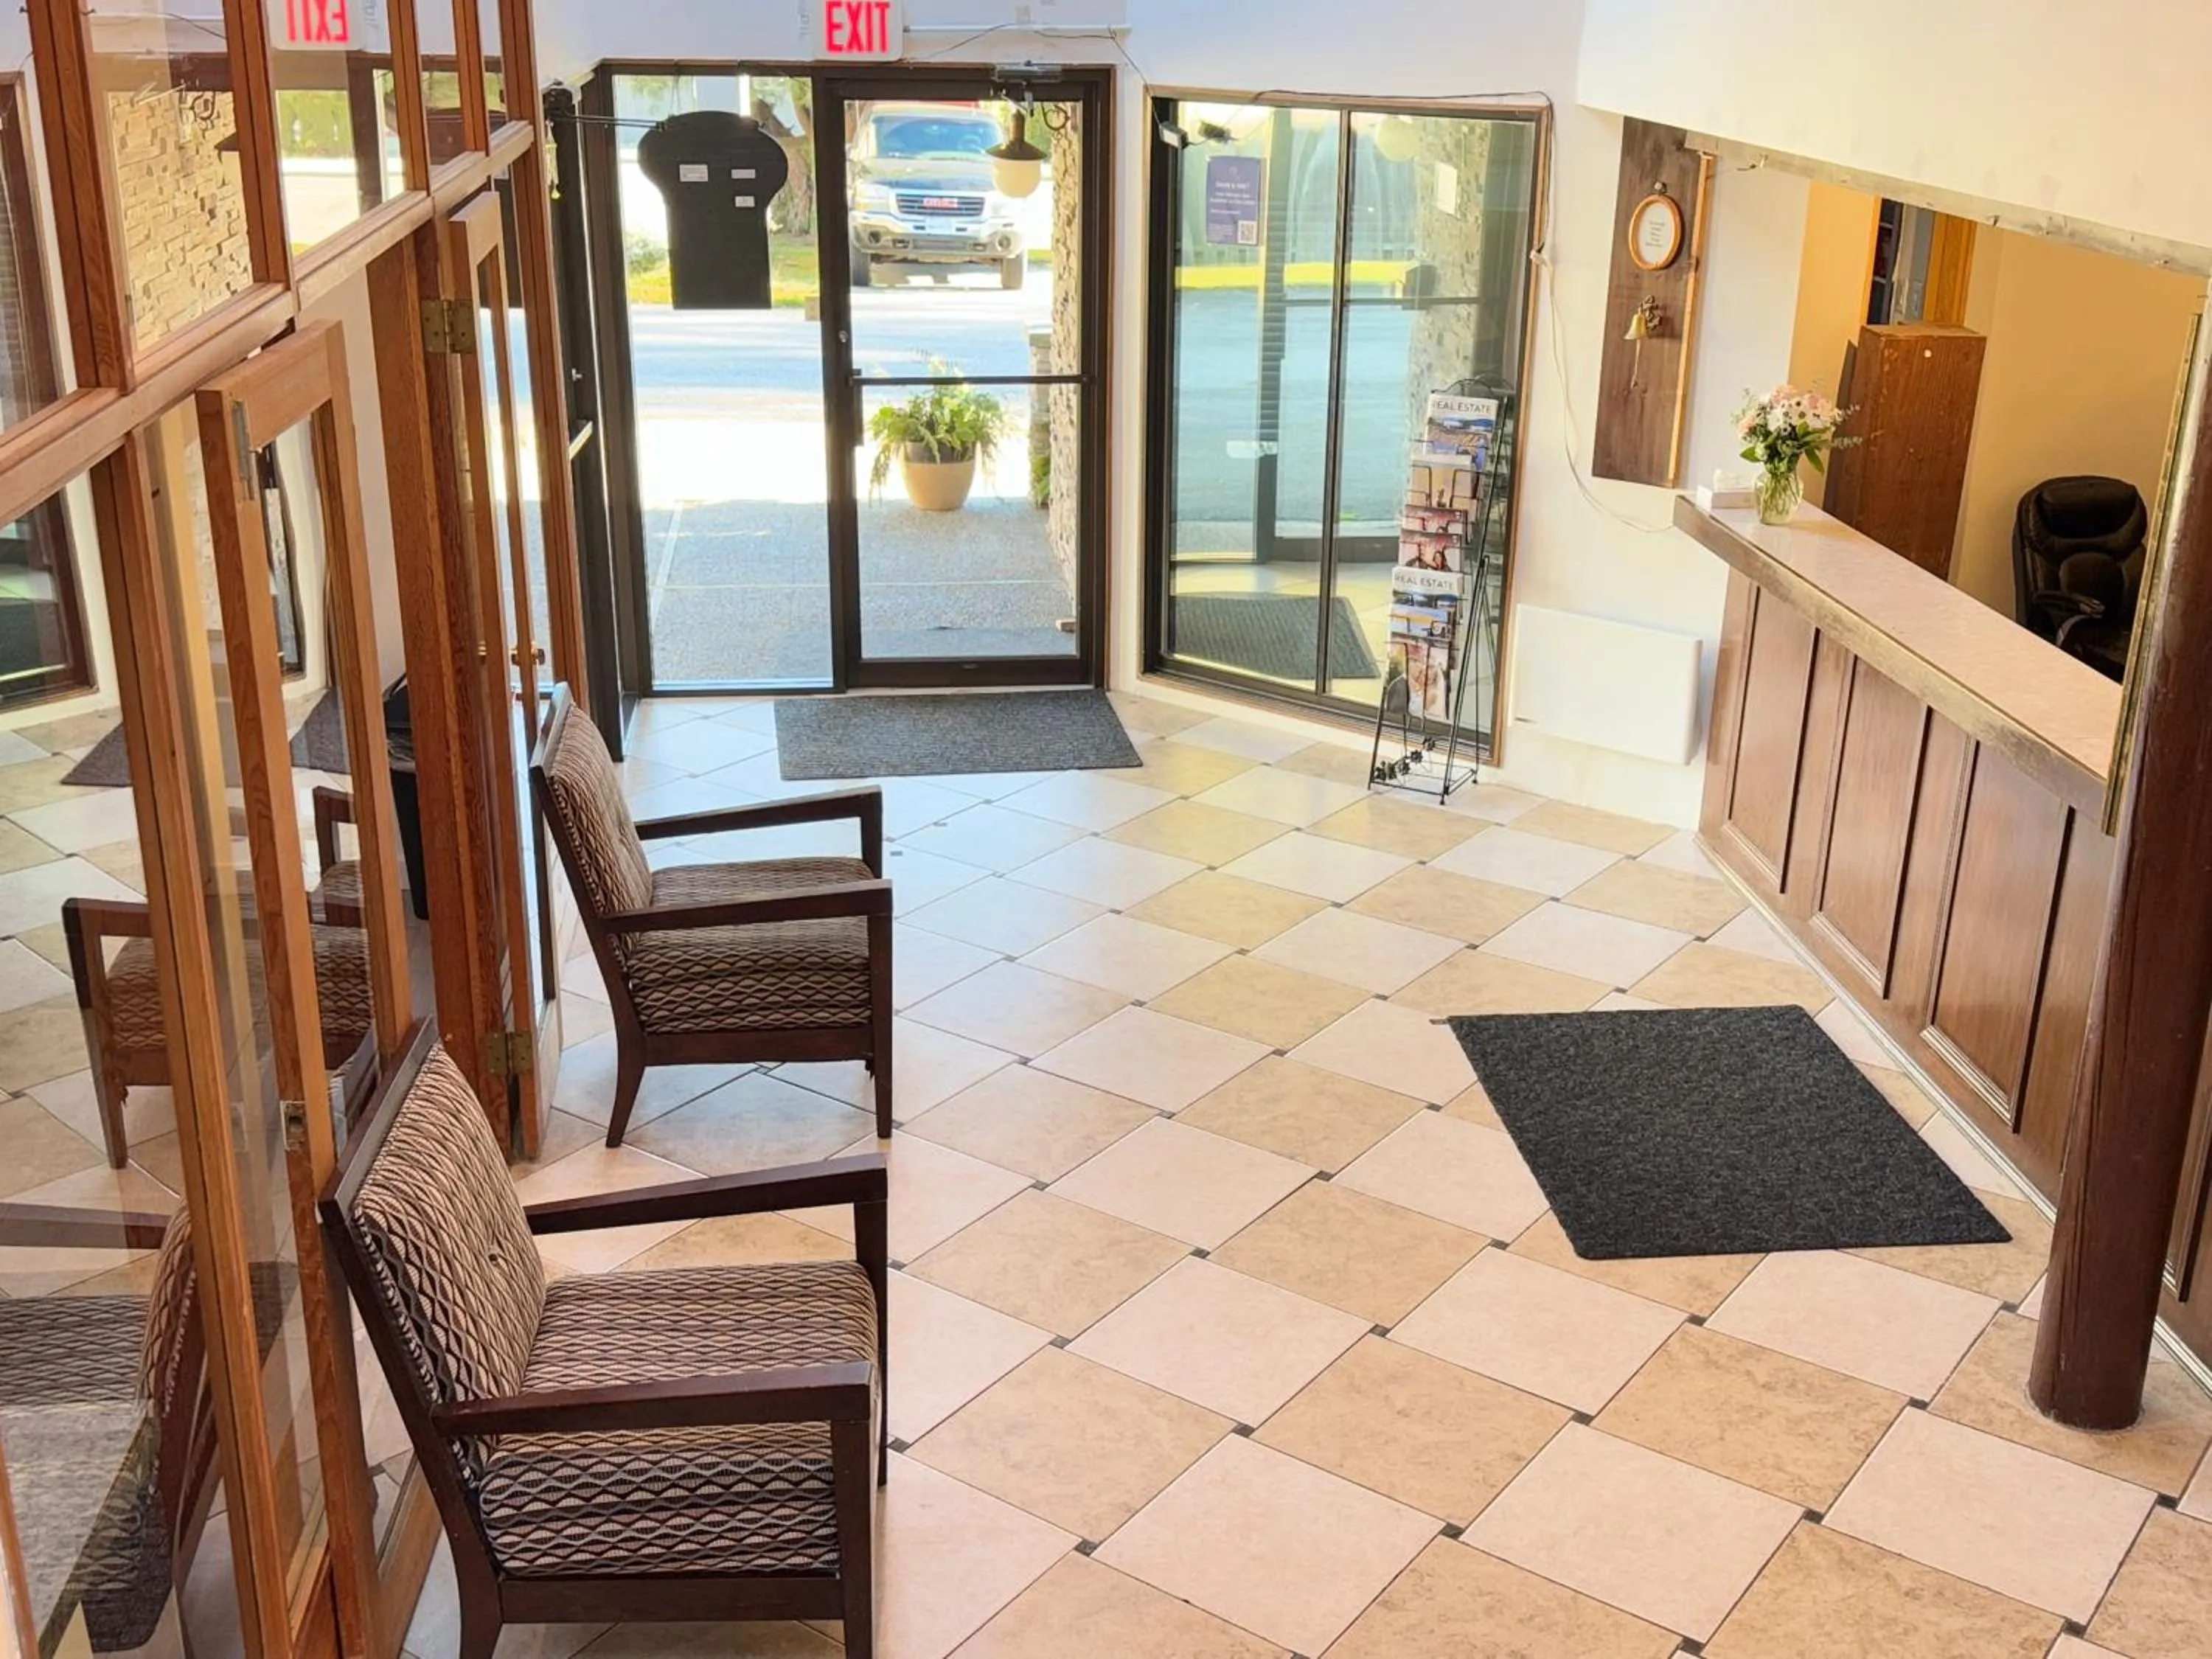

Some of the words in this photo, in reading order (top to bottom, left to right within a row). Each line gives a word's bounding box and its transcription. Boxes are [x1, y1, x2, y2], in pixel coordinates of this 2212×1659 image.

[826, 1, 891, 53] EXIT
[1458, 402, 1491, 414] ESTATE
[1394, 574, 1418, 586] REAL
[1420, 577, 1455, 590] ESTATE
